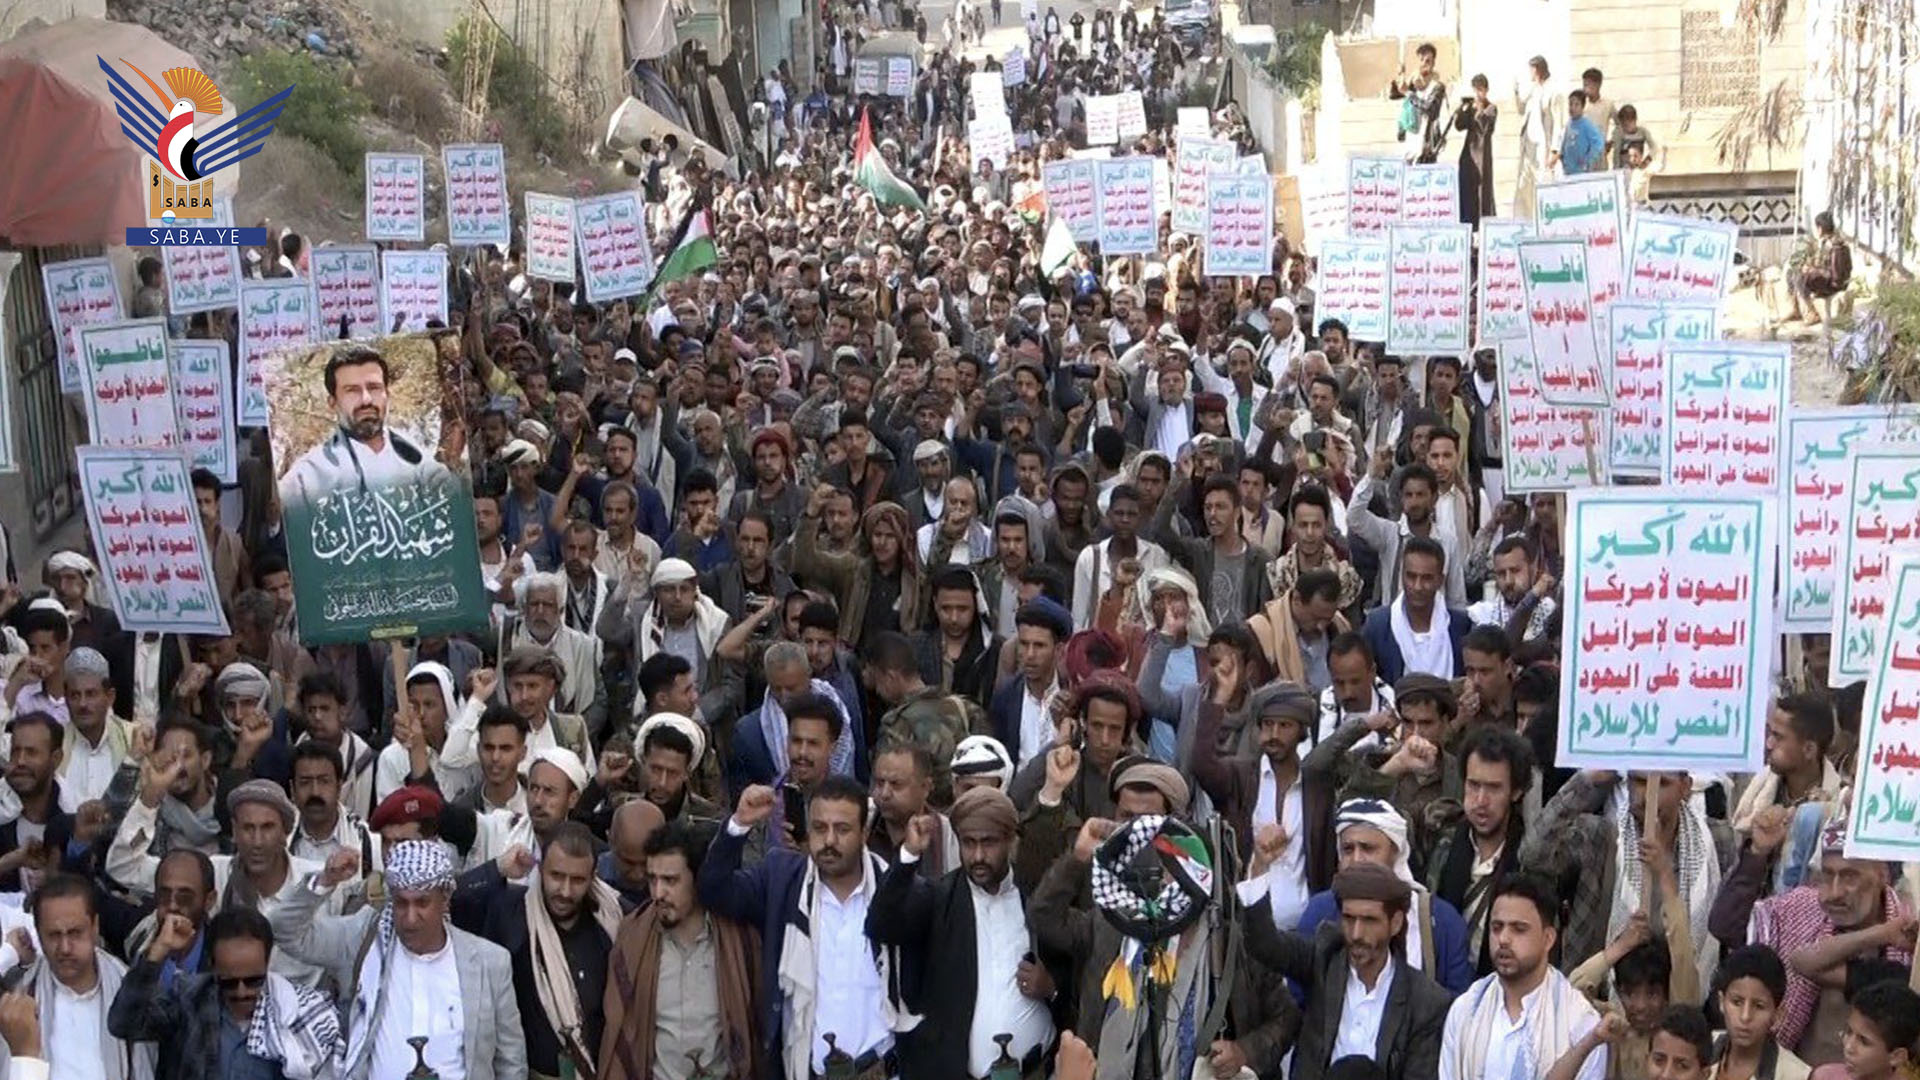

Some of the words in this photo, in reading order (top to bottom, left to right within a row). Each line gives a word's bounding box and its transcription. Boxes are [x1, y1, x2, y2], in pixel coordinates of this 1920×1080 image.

[1540, 192, 1614, 225] قاطعوا
[1525, 255, 1584, 290] قاطعوا
[89, 337, 163, 371] قاطعوا
[1678, 356, 1737, 396] أكبر
[1741, 361, 1778, 390] الله
[1675, 397, 1729, 423] لأمريكا
[1733, 403, 1777, 425] الموت
[1733, 434, 1775, 455] الموت
[1795, 421, 1868, 469] كبر
[1674, 463, 1712, 484] اليهود
[1716, 464, 1736, 485] على
[1743, 462, 1775, 484] اللعنة
[1794, 473, 1843, 500] مريكا
[1588, 508, 1686, 569] أكبر
[1689, 511, 1751, 555] الله
[1584, 567, 1670, 607] لأمريكا
[1677, 575, 1747, 606] الموت
[1581, 617, 1667, 651] لإسرائيل
[1675, 620, 1745, 650] الموت
[1580, 663, 1639, 694] اليهود
[1647, 662, 1680, 693] على
[1690, 664, 1743, 689] اللعنة
[1578, 702, 1659, 746] للإسلام
[1667, 700, 1739, 744] النصر
